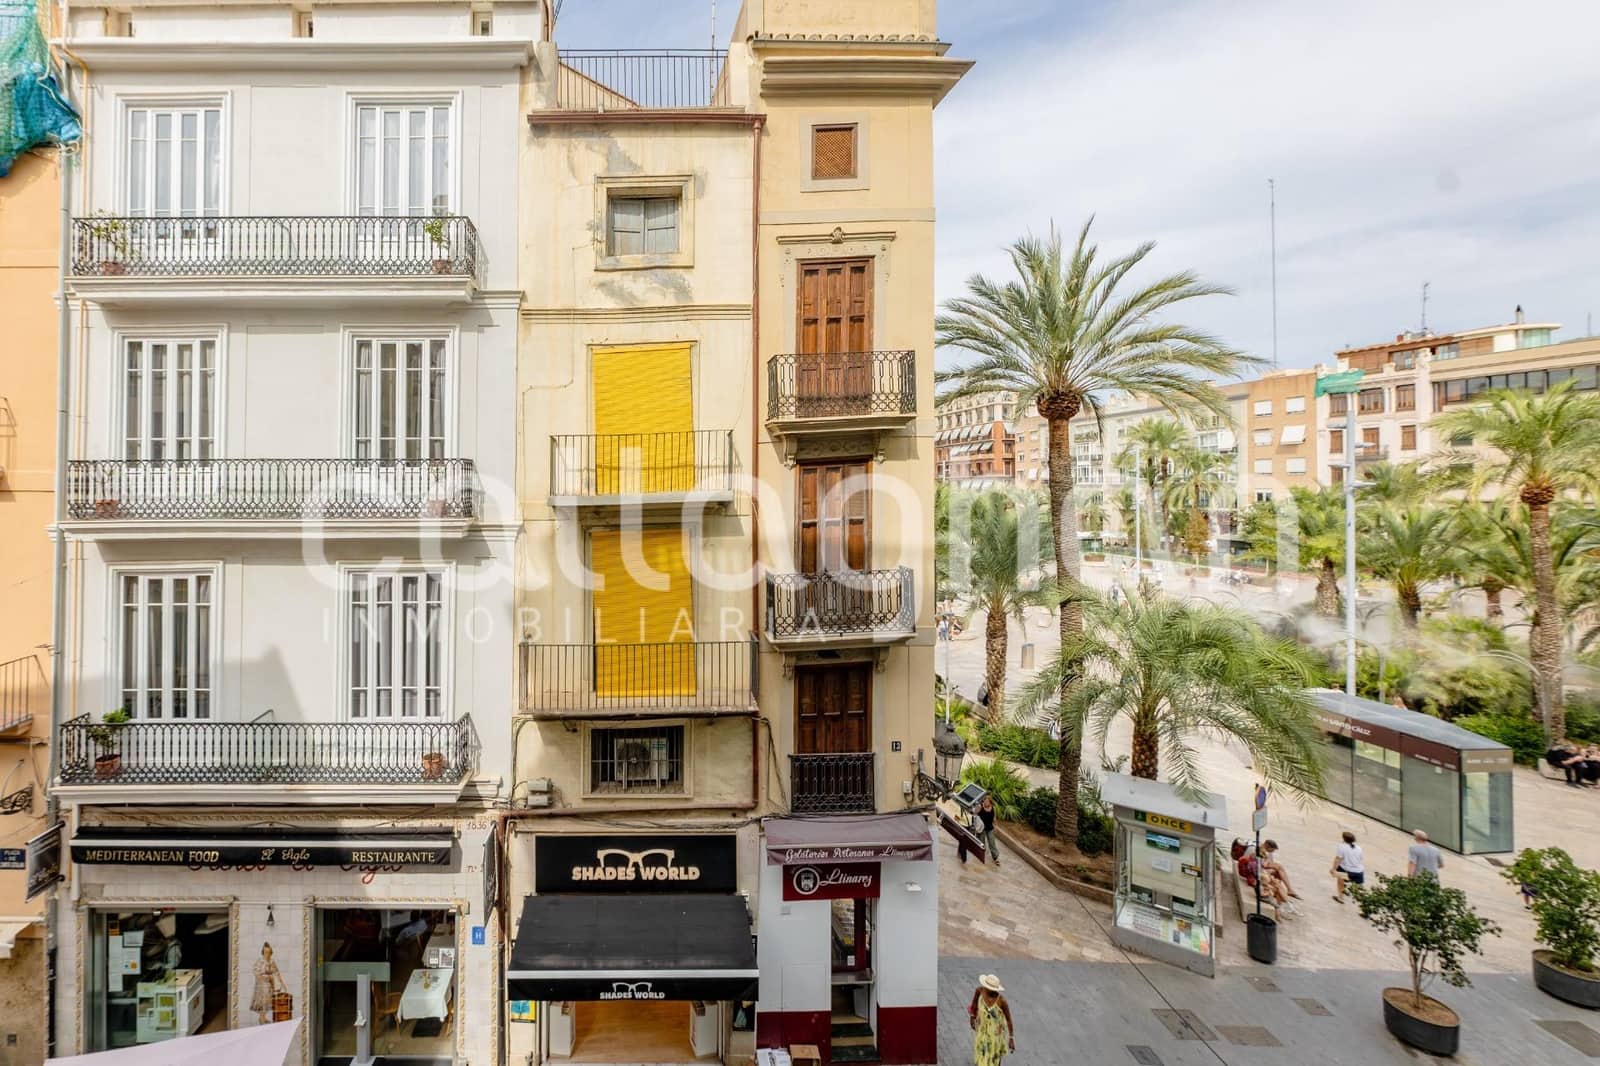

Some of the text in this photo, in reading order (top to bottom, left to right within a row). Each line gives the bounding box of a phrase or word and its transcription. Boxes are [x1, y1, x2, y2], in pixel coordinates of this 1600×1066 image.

[1150, 815, 1185, 830] ONCE
[86, 850, 183, 862] MEDITERRANEAN
[188, 850, 219, 863] FOOD
[261, 848, 276, 861] El
[352, 851, 436, 863] RESTAURANTE
[572, 866, 700, 881] SHADES WORLD
[599, 991, 666, 1000] SHADES WORLD
